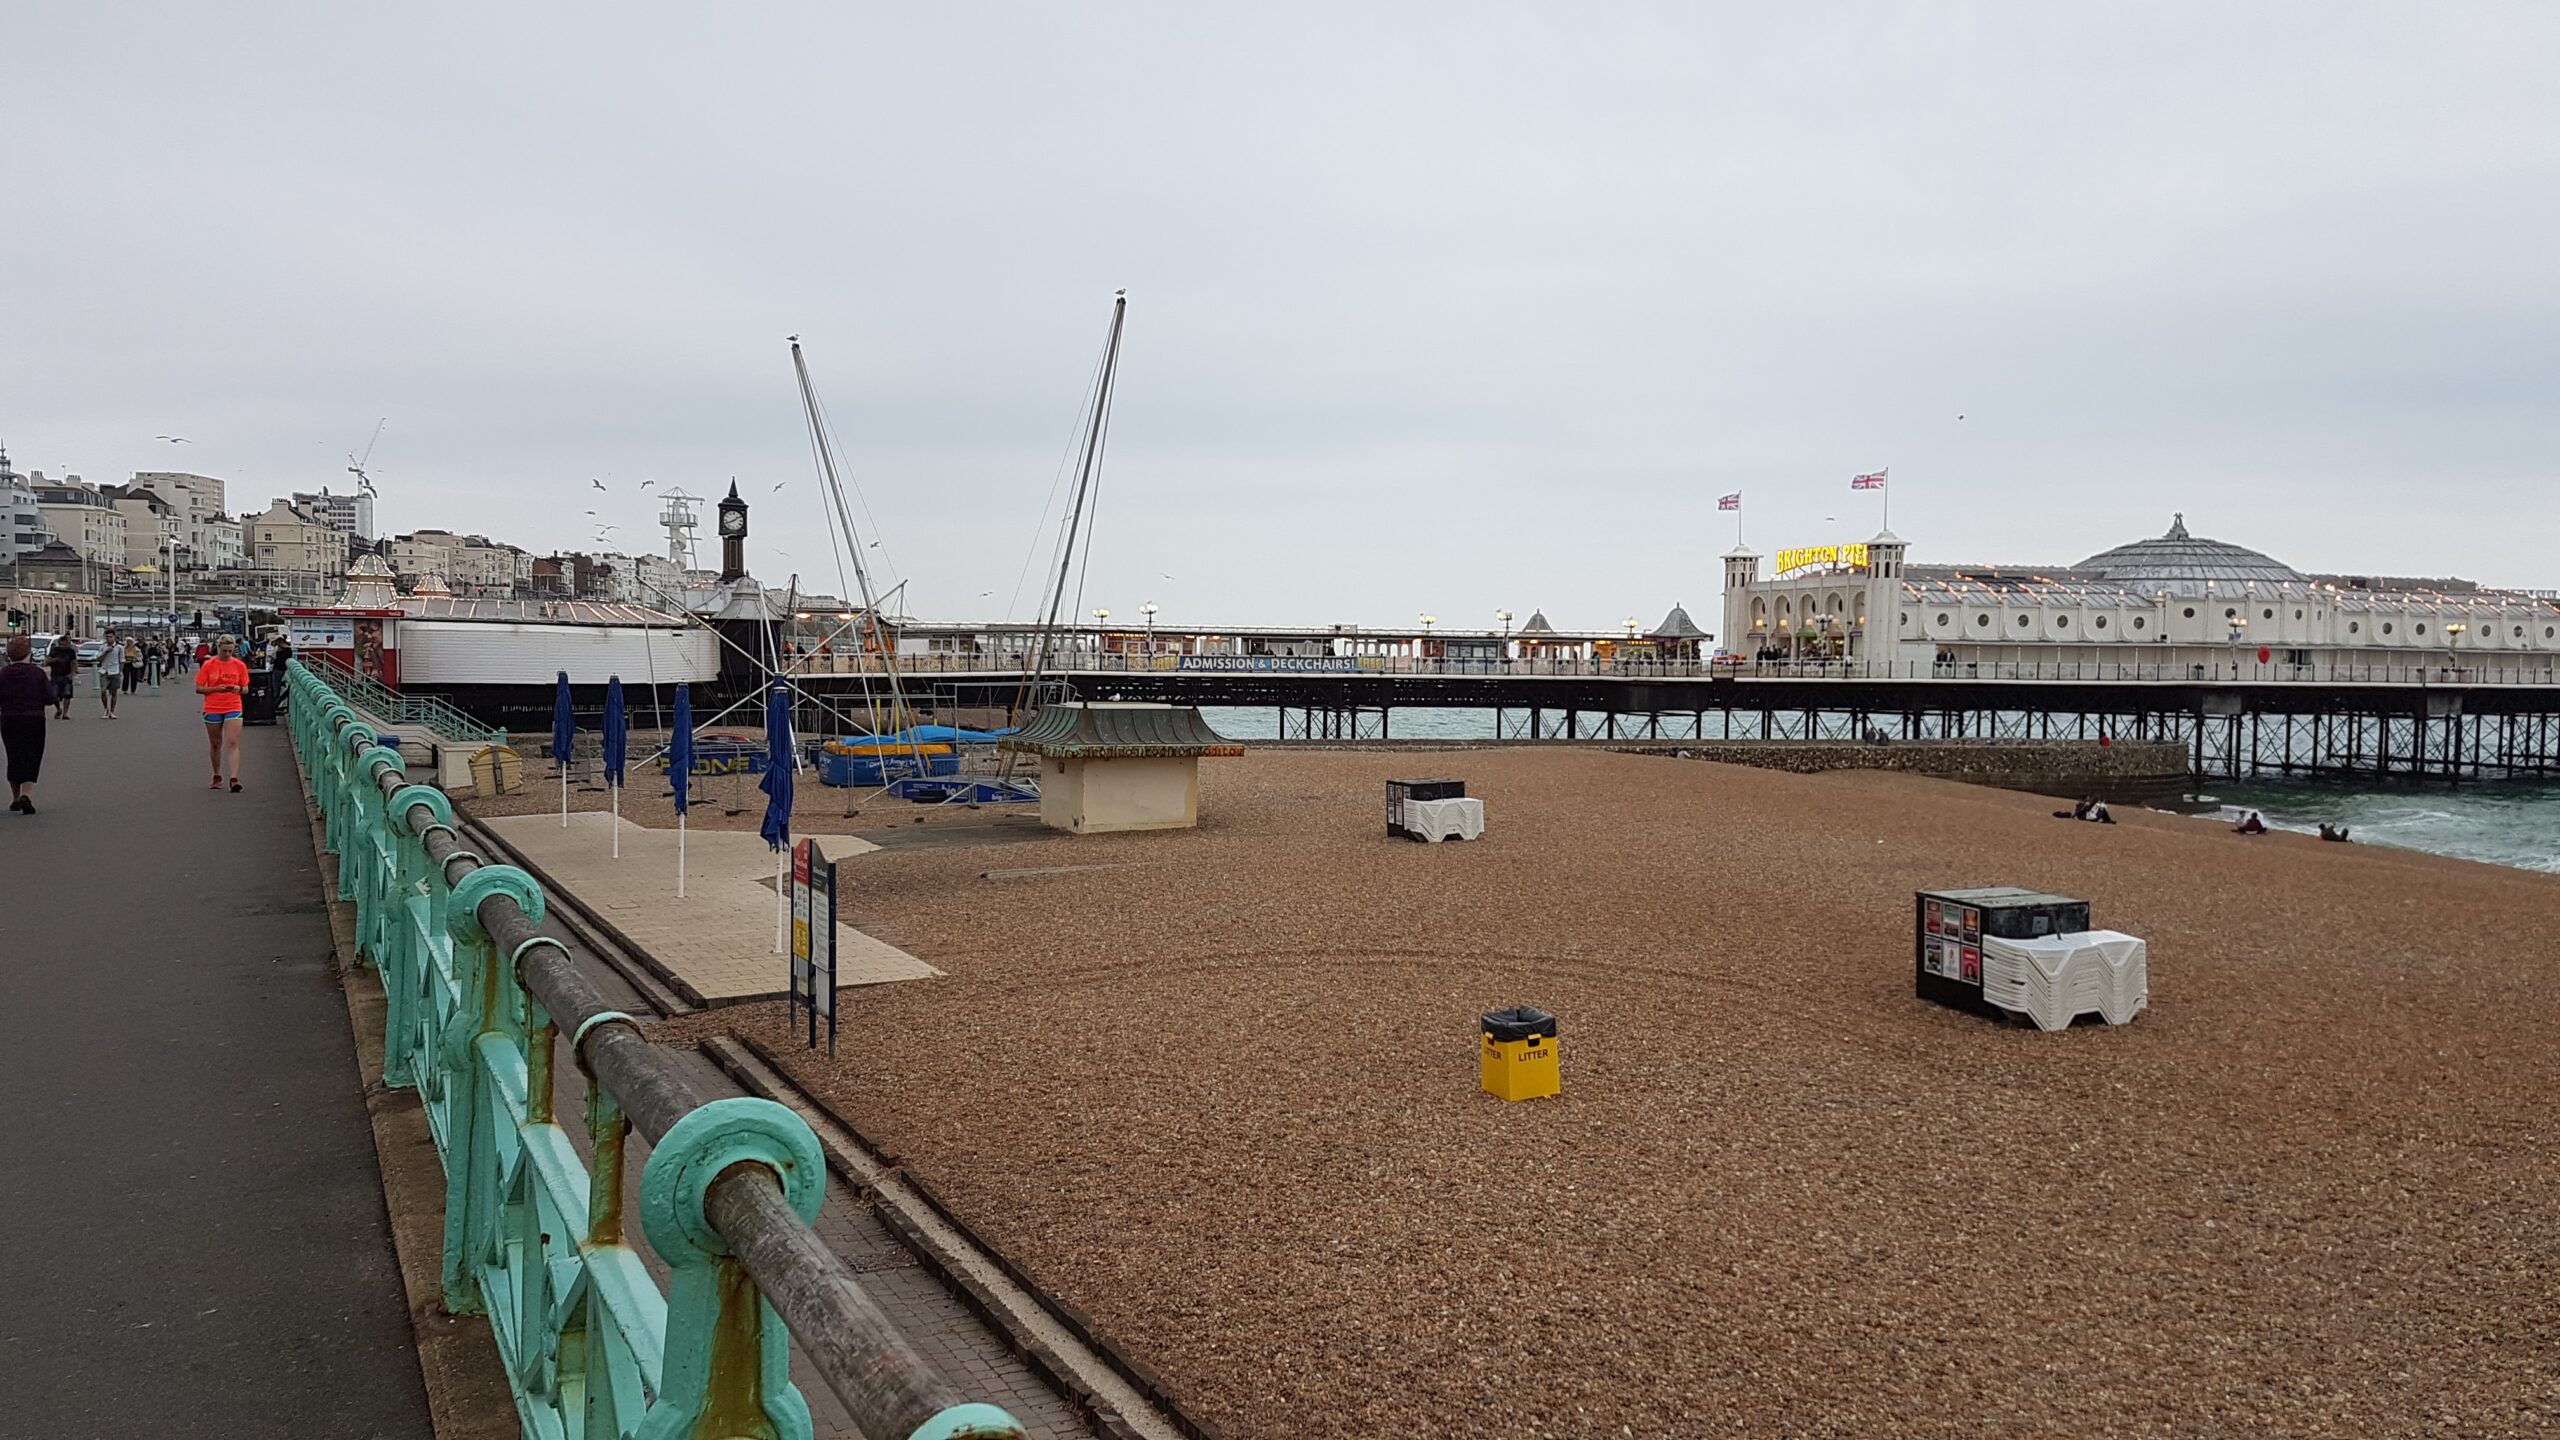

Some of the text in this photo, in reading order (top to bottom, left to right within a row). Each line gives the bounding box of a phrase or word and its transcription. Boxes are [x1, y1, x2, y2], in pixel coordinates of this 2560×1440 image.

[1776, 546, 1838, 575] BRIGHTON
[1183, 656, 1253, 670] ADMISSION
[1258, 658, 1266, 668] &
[1271, 657, 1353, 670] DECKCHAIRS!
[1484, 1046, 1502, 1061] LITTER
[1518, 1049, 1548, 1061] LITTER
